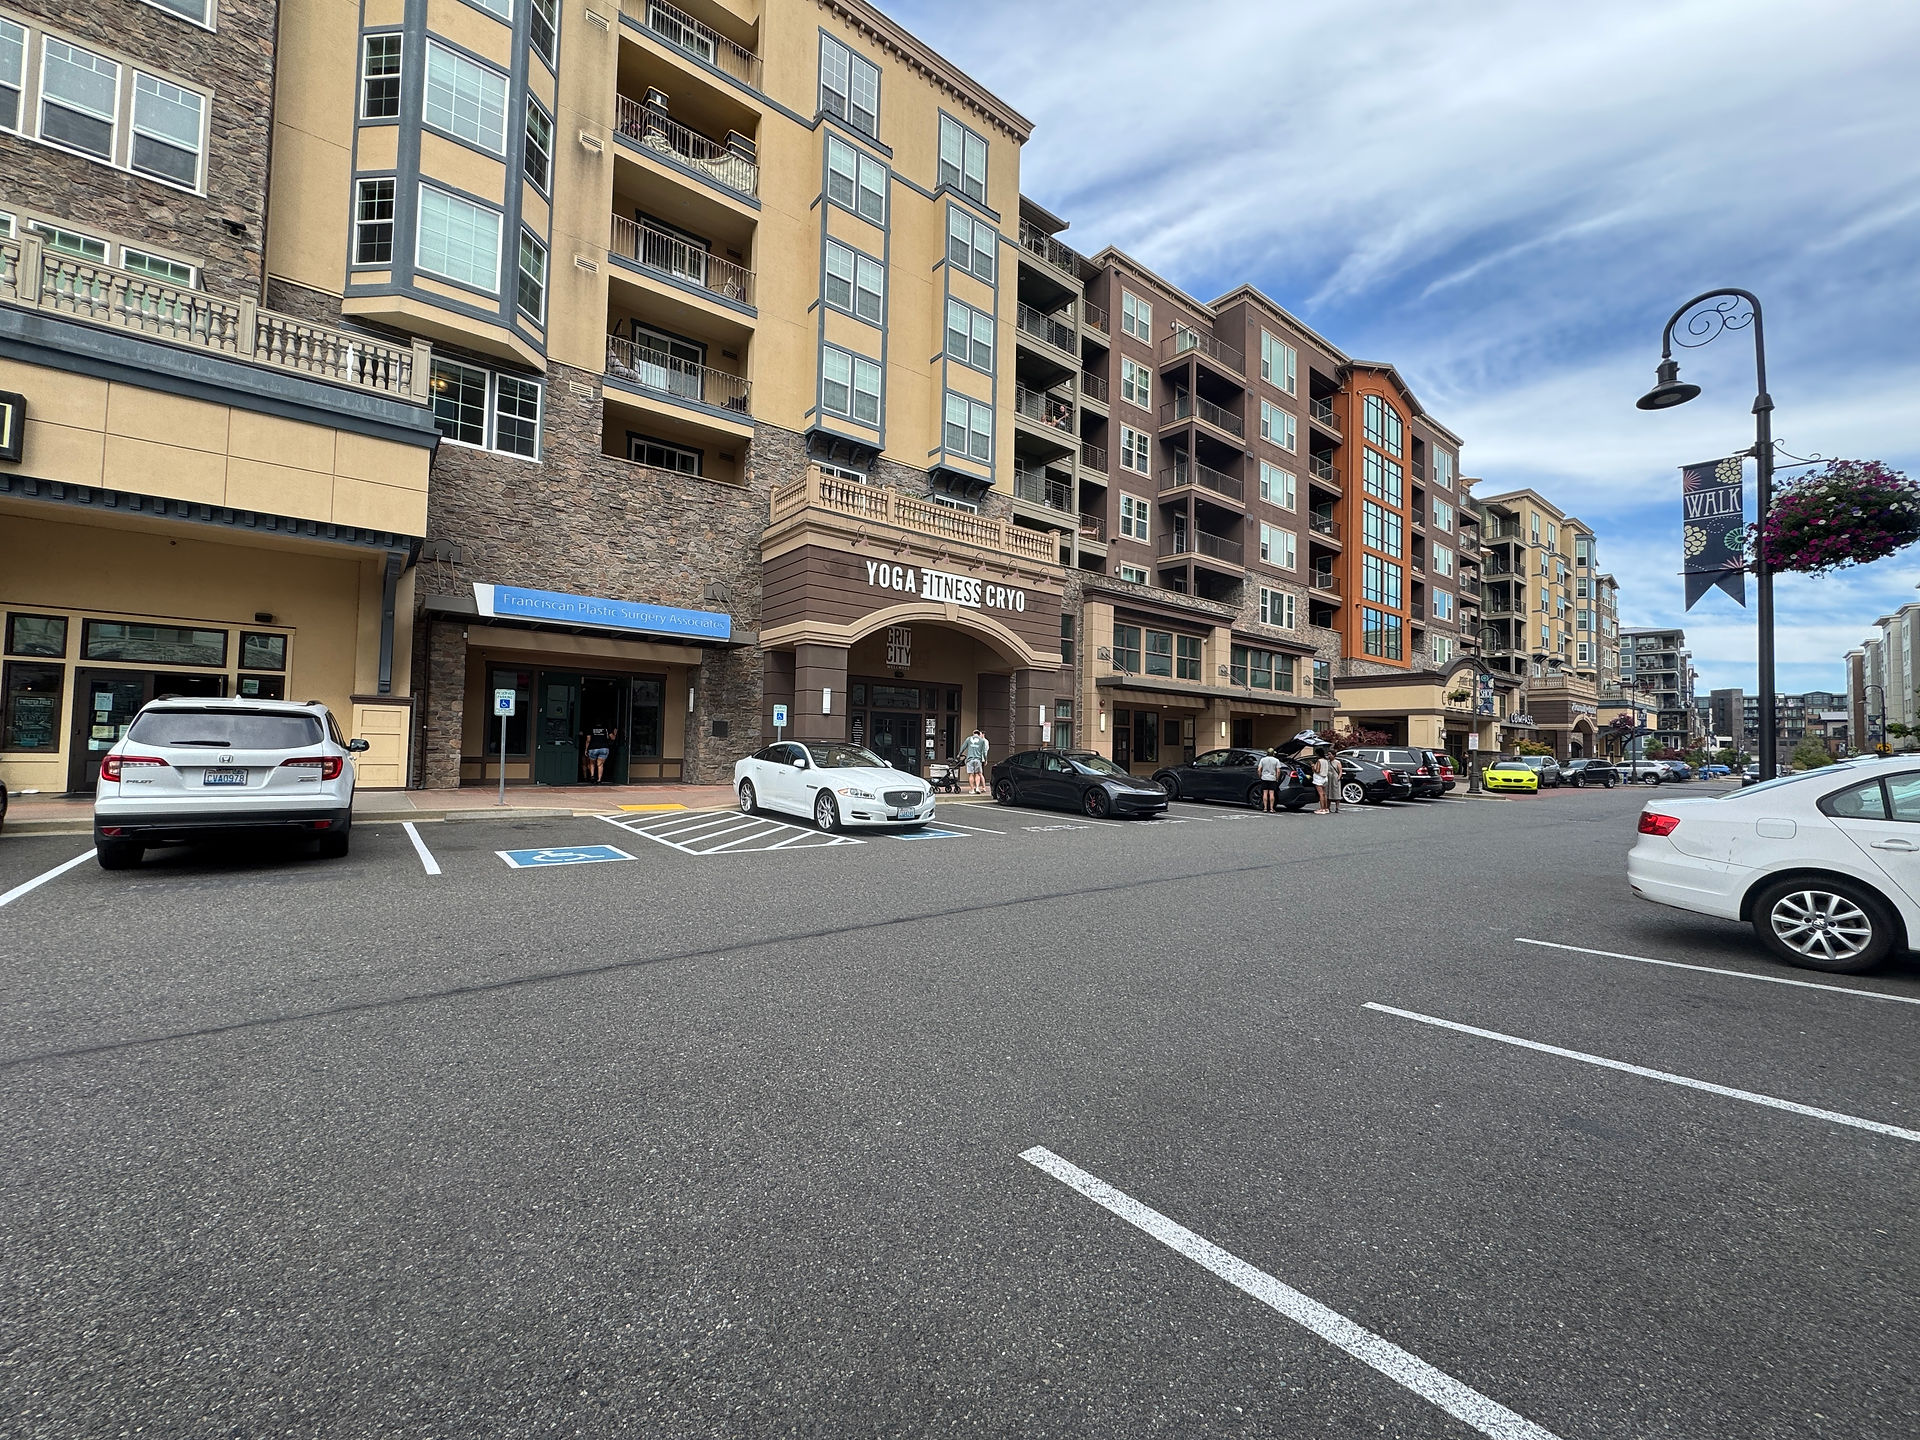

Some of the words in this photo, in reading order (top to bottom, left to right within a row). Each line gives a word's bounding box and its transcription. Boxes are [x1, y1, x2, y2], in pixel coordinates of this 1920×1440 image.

[1685, 488, 1741, 518] WALK
[866, 561, 916, 593] YOGA
[921, 570, 981, 607] FITNESS
[985, 585, 1025, 612] CRYO
[503, 593, 575, 612] Franciscan
[578, 602, 619, 618] Plastic
[620, 608, 667, 625] Surgery
[669, 614, 725, 630] Associates
[887, 626, 911, 647] GRIT
[886, 645, 911, 665] CITY
